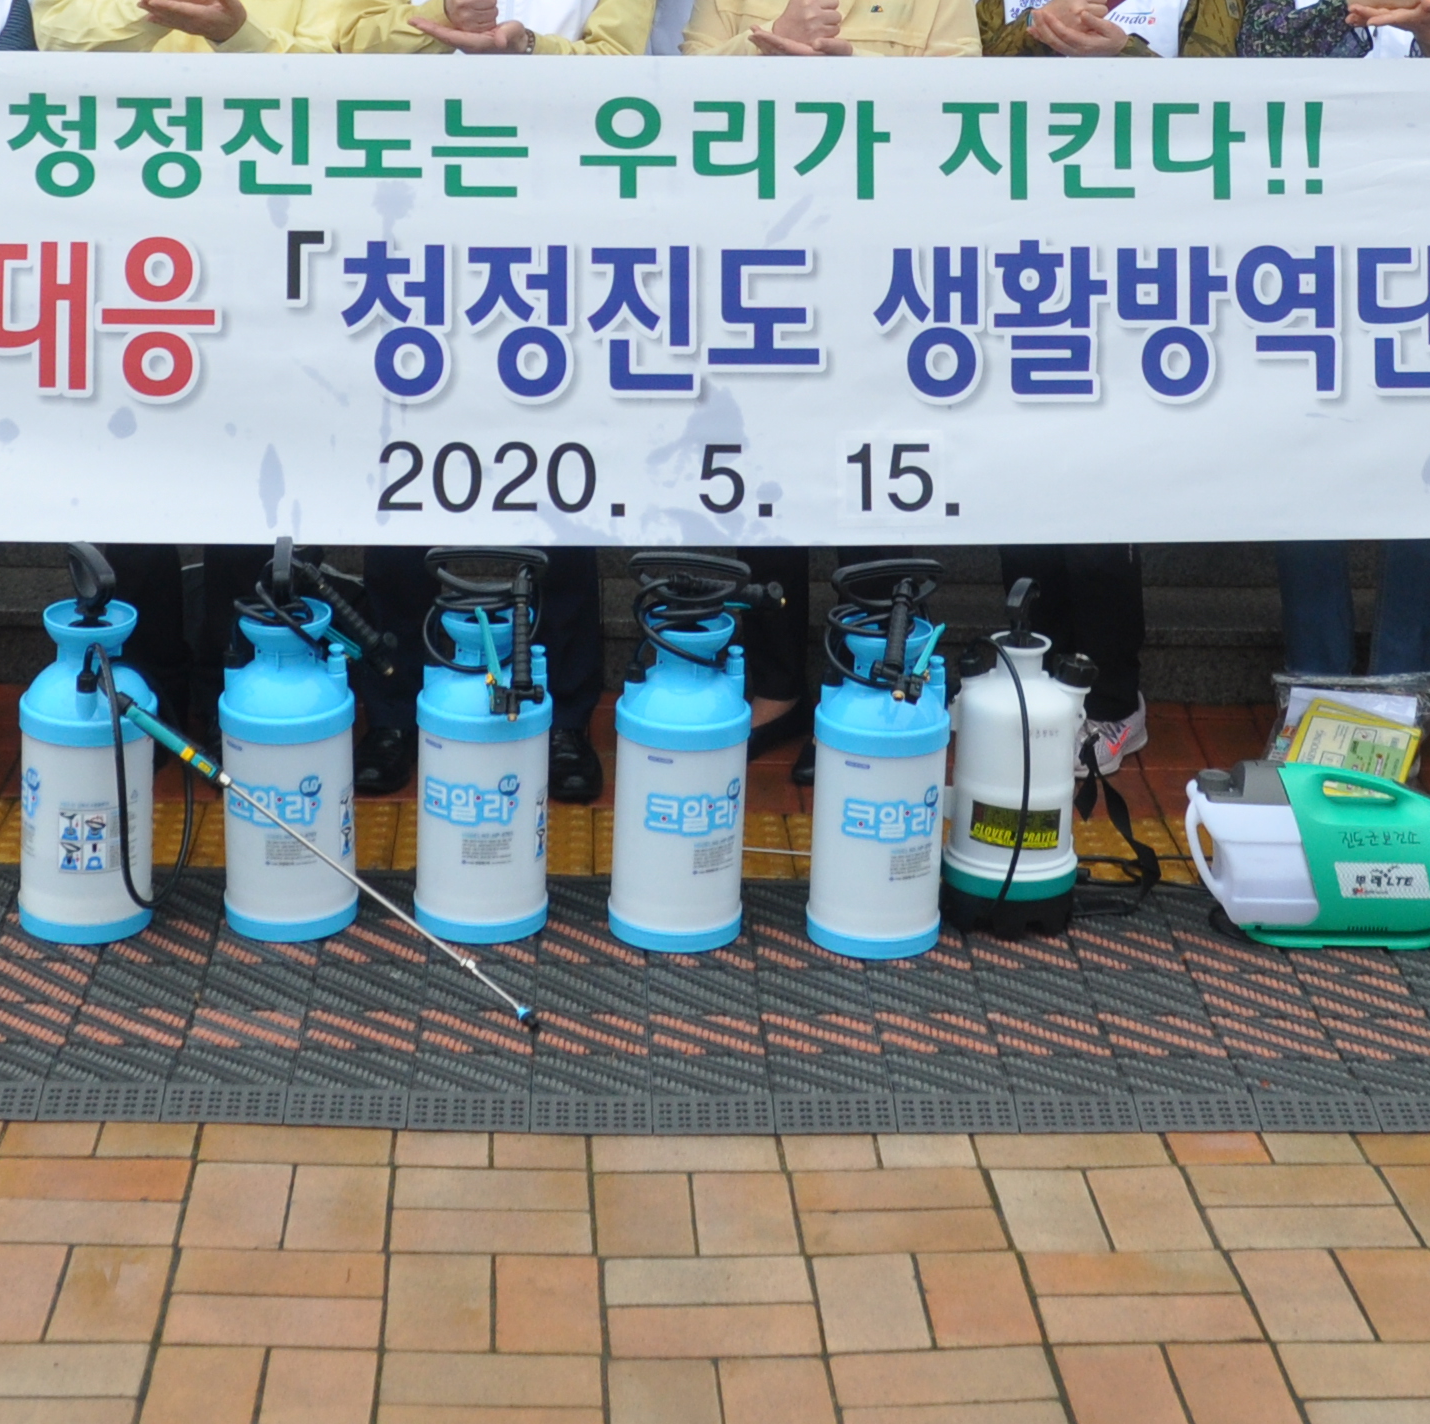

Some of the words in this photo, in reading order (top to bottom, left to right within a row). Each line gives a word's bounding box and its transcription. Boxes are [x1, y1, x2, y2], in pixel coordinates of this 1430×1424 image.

[1108, 11, 1147, 24] Jindo
[7, 92, 528, 198] 청정진도는
[580, 96, 890, 199] 우리가
[939, 100, 1324, 199] 지킨다!!
[377, 441, 626, 518] 2020.
[698, 444, 773, 518] 5.
[846, 442, 960, 517] 15.
[426, 778, 515, 823] 코알라
[648, 796, 737, 833] 코알라
[844, 803, 935, 838] 코알라
[973, 823, 1012, 840] CLOVER
[1015, 830, 1058, 843] PRAYER
